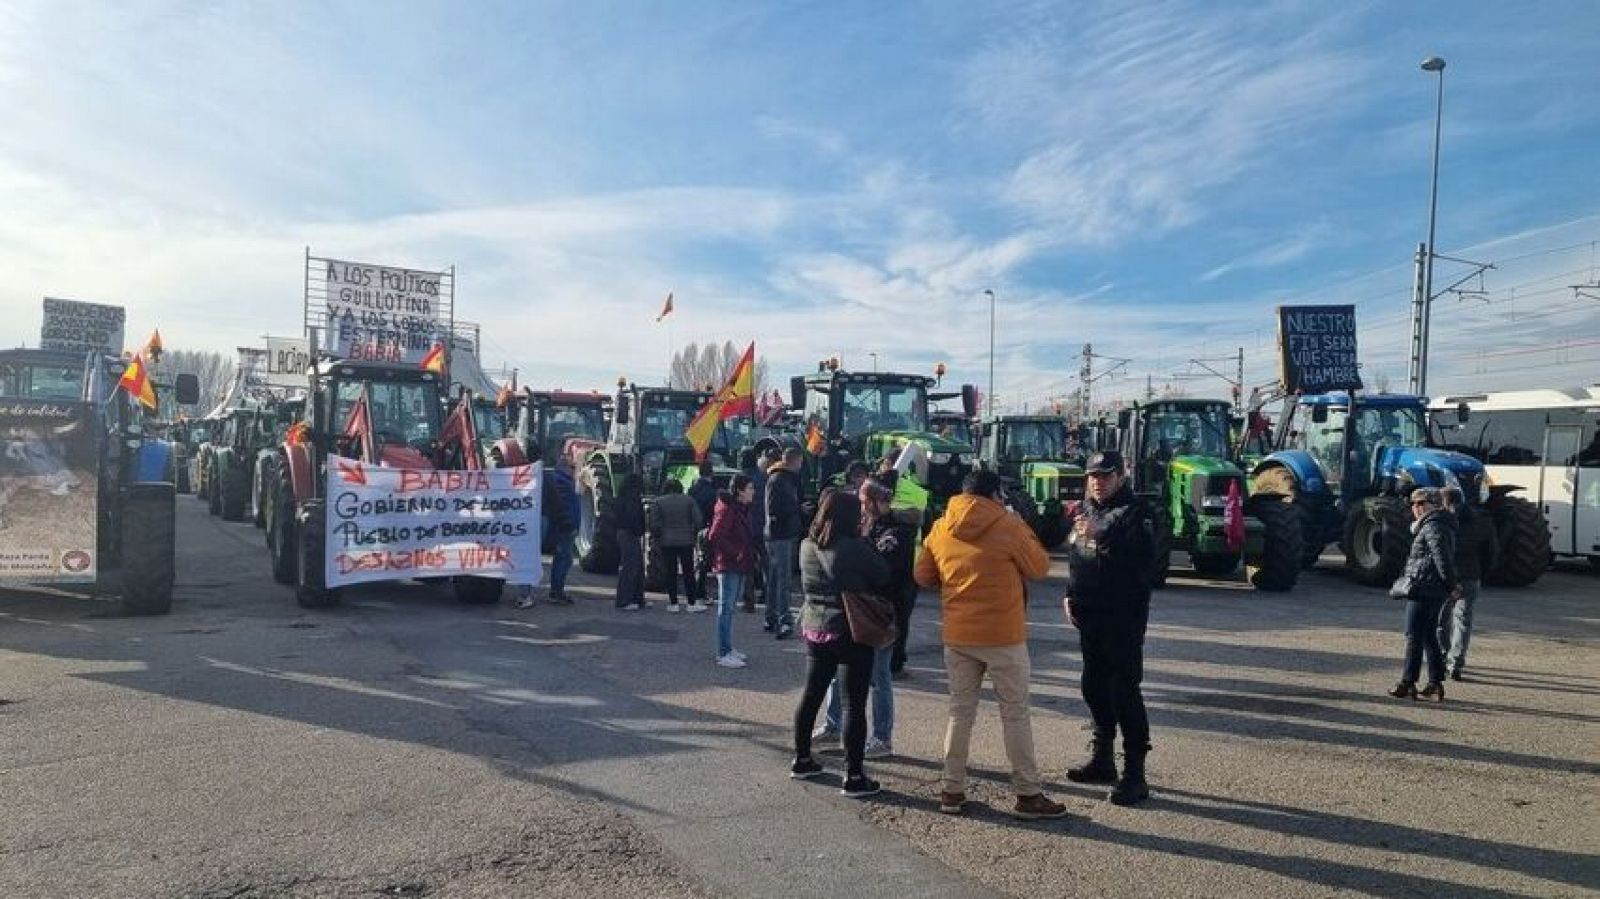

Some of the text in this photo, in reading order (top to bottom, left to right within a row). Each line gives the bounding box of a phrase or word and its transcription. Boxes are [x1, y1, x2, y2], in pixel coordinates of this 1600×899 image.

[326, 261, 337, 281] A
[344, 264, 374, 287] LOS
[340, 287, 431, 315] GUILLOTINA
[327, 302, 437, 333] Y A LOS LOBOS
[395, 470, 490, 492] BABIA
[481, 496, 533, 512] LOBOS
[333, 520, 411, 548] PUEBLO
[441, 521, 527, 538] BORREGOS
